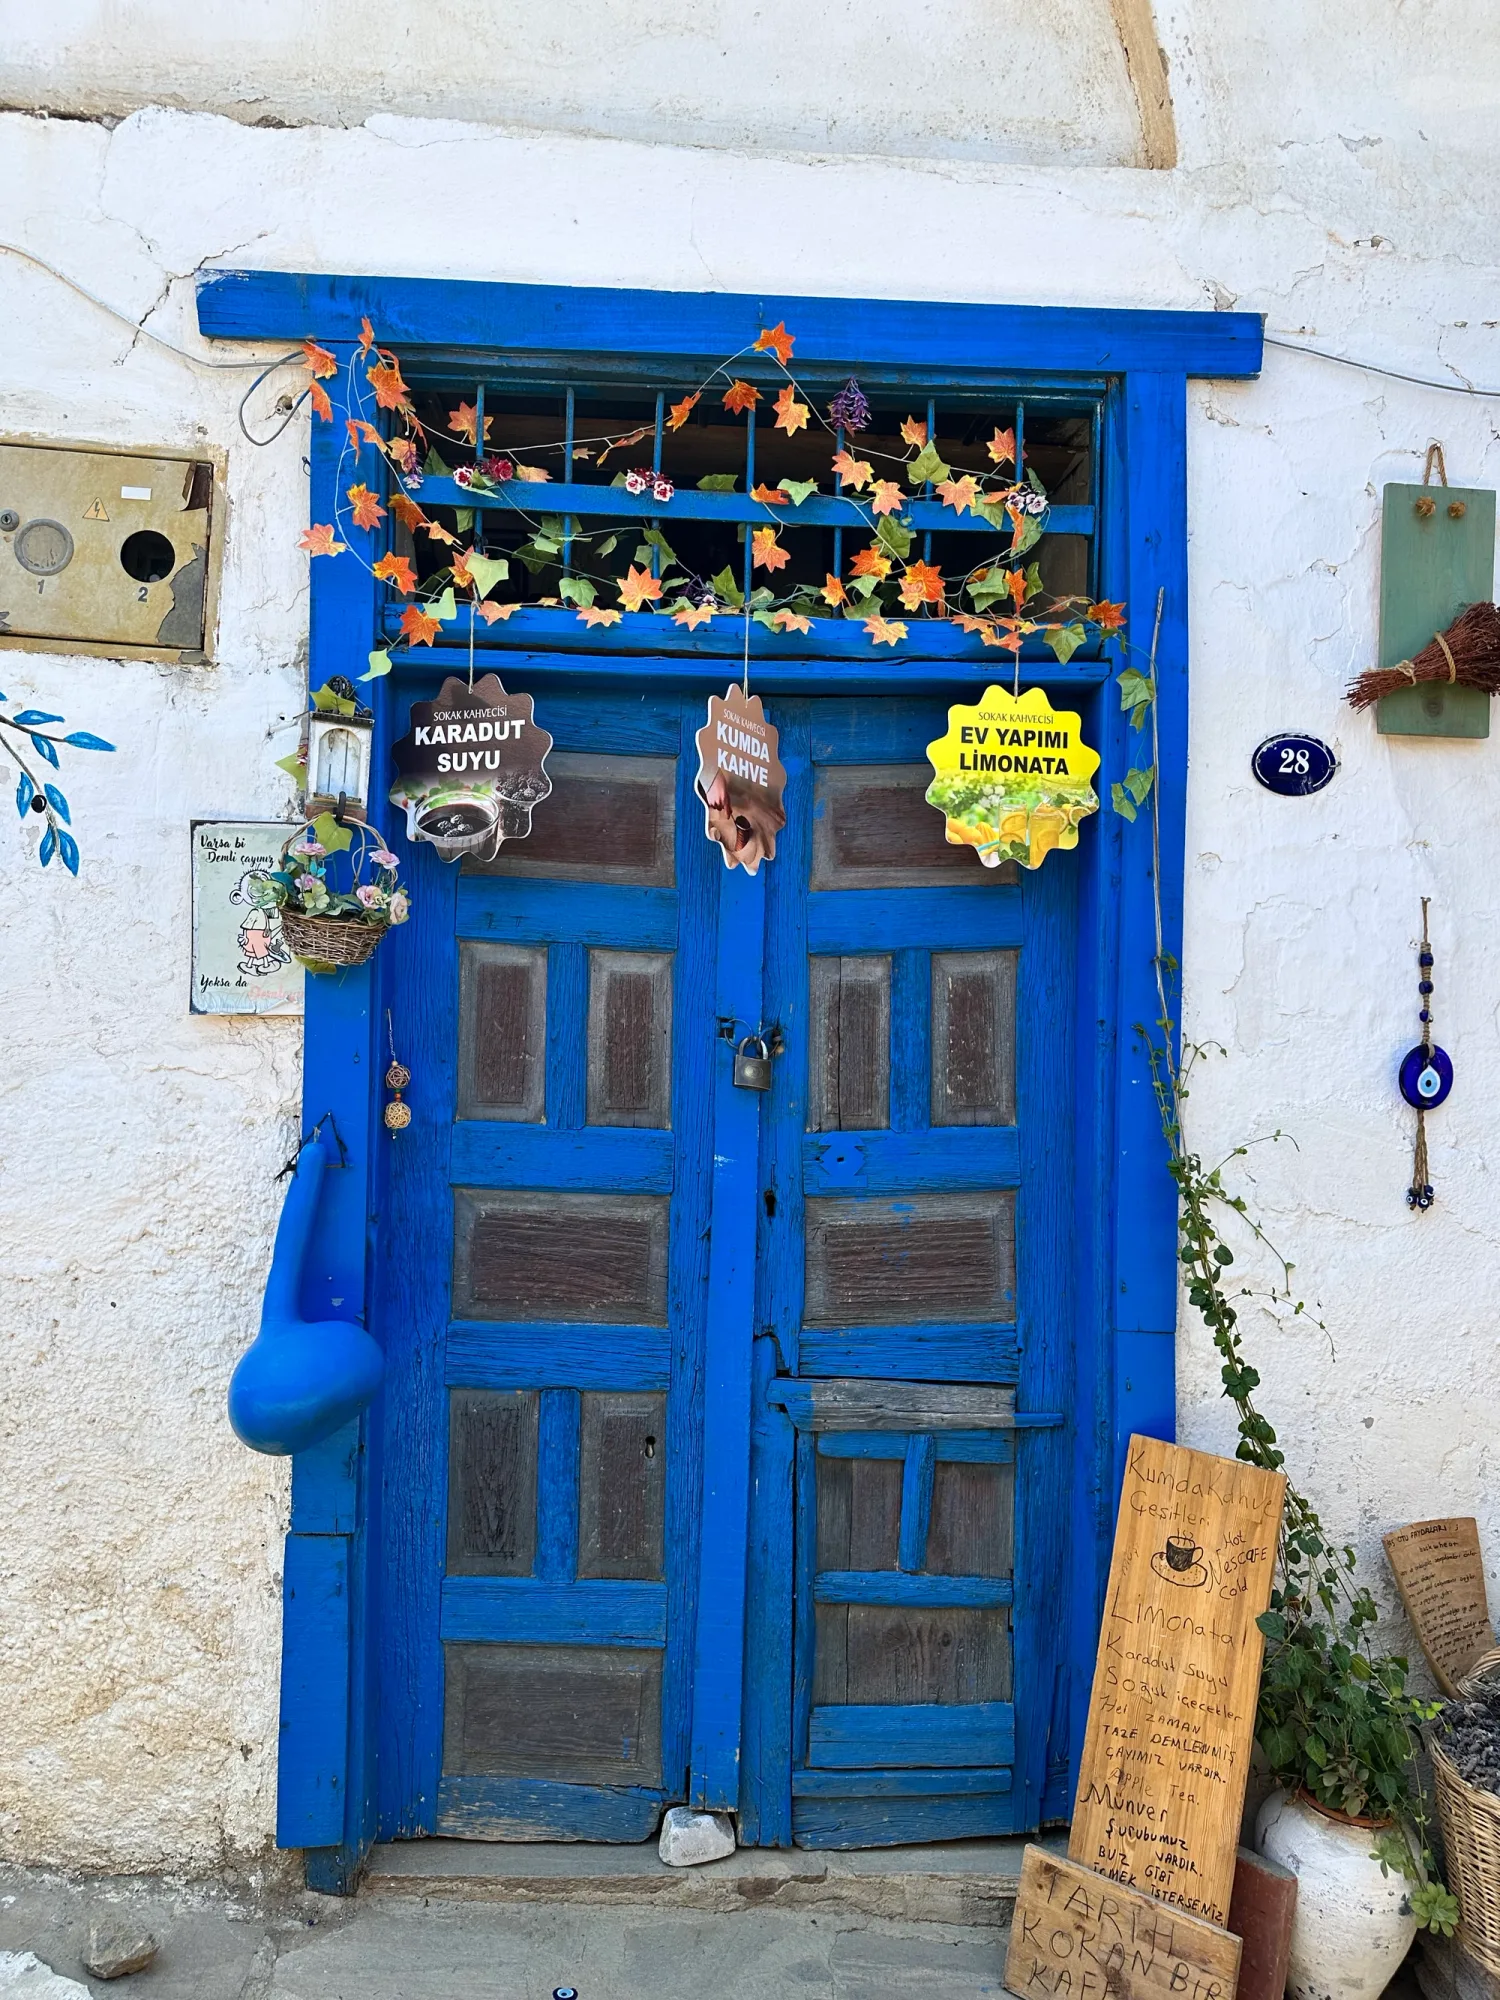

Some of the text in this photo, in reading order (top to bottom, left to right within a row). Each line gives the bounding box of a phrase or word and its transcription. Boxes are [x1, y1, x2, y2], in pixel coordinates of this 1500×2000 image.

[37, 579, 45, 595] 1
[137, 586, 148, 603] 2
[433, 705, 507, 722] SOKAK KAHVECİSİ
[978, 711, 1054, 725] SOKAK KAHVECİSİ
[415, 719, 526, 746] KARADUT
[716, 720, 770, 763] KUMDA
[960, 726, 1069, 749] EV YAPIMI
[437, 750, 500, 773] SUYU
[717, 748, 768, 788] KAHVE
[959, 749, 1069, 776] LİMONATA
[1278, 748, 1310, 775] 28
[200, 835, 247, 851] Varsa bi
[205, 851, 275, 869] Demli çayınız
[235, 975, 249, 988] da
[1145, 1712, 1201, 1735] ZAMAN
[1022, 1911, 1155, 1977] KOKAN
